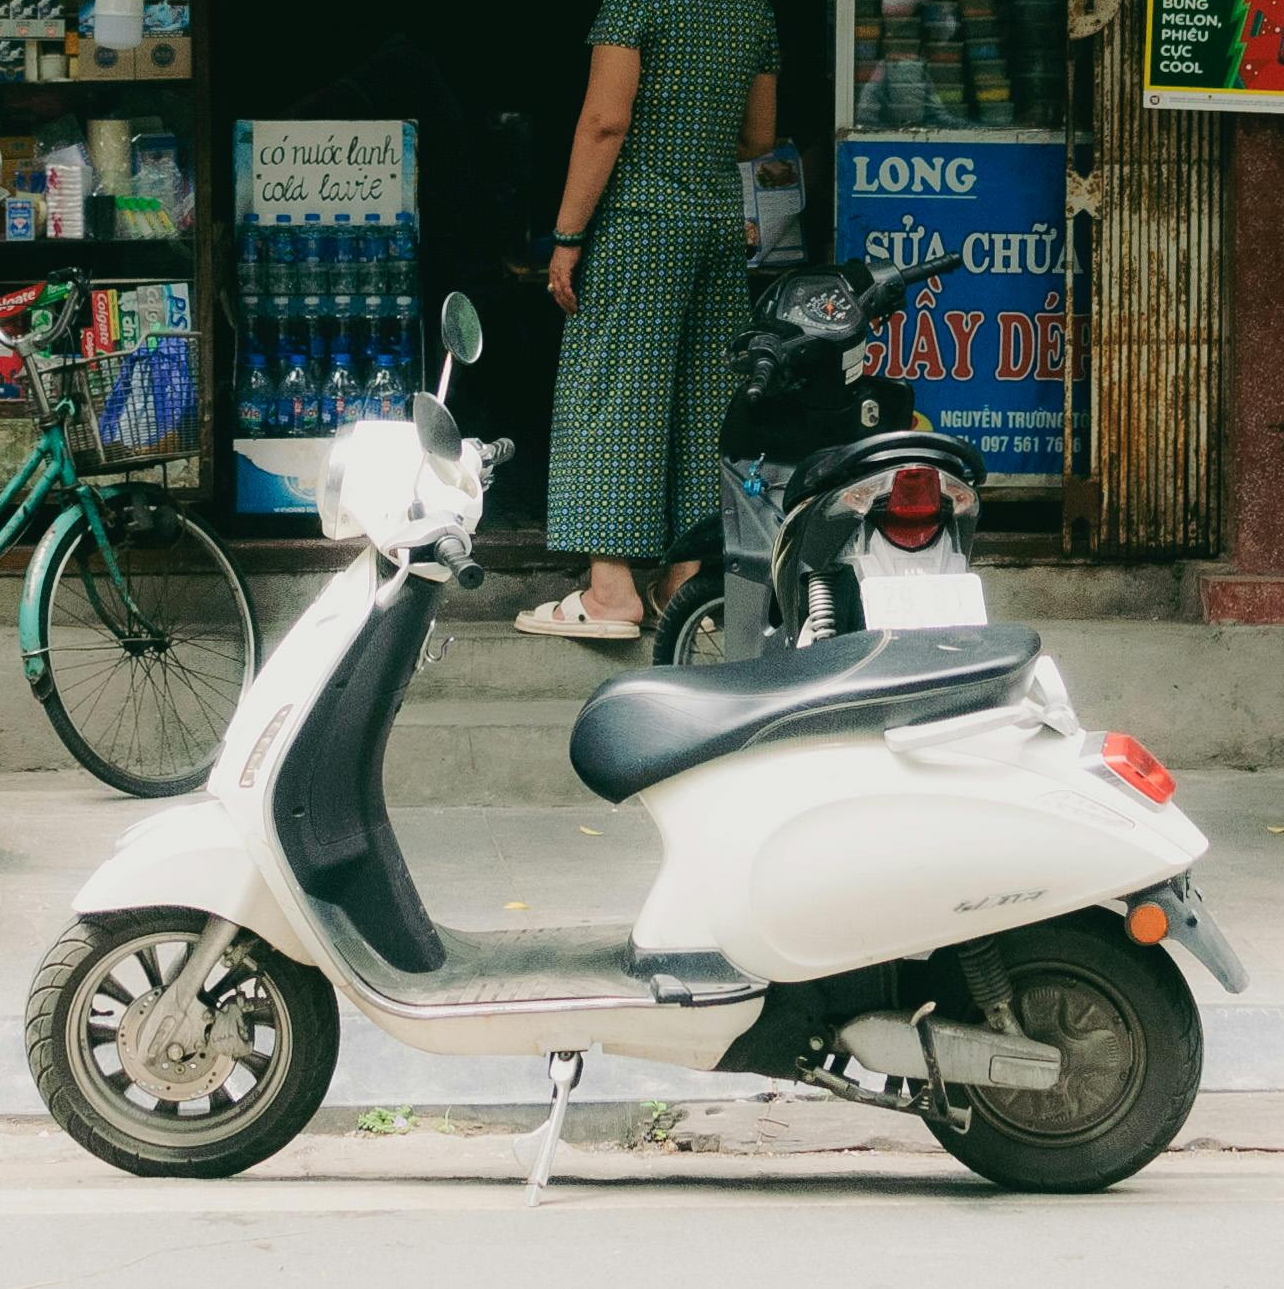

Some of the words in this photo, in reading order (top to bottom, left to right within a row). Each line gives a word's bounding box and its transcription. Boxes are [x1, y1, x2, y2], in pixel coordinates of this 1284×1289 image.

[1162, 12, 1222, 28] MELON,
[1160, 44, 1192, 61] CỰC
[1160, 60, 1203, 74] COOL
[260, 135, 288, 166] có
[852, 156, 977, 193] LONG
[96, 292, 110, 346] Colgate
[981, 436, 1009, 453] 097
[1013, 436, 1040, 453] 561
[1046, 437, 1082, 453] 766
